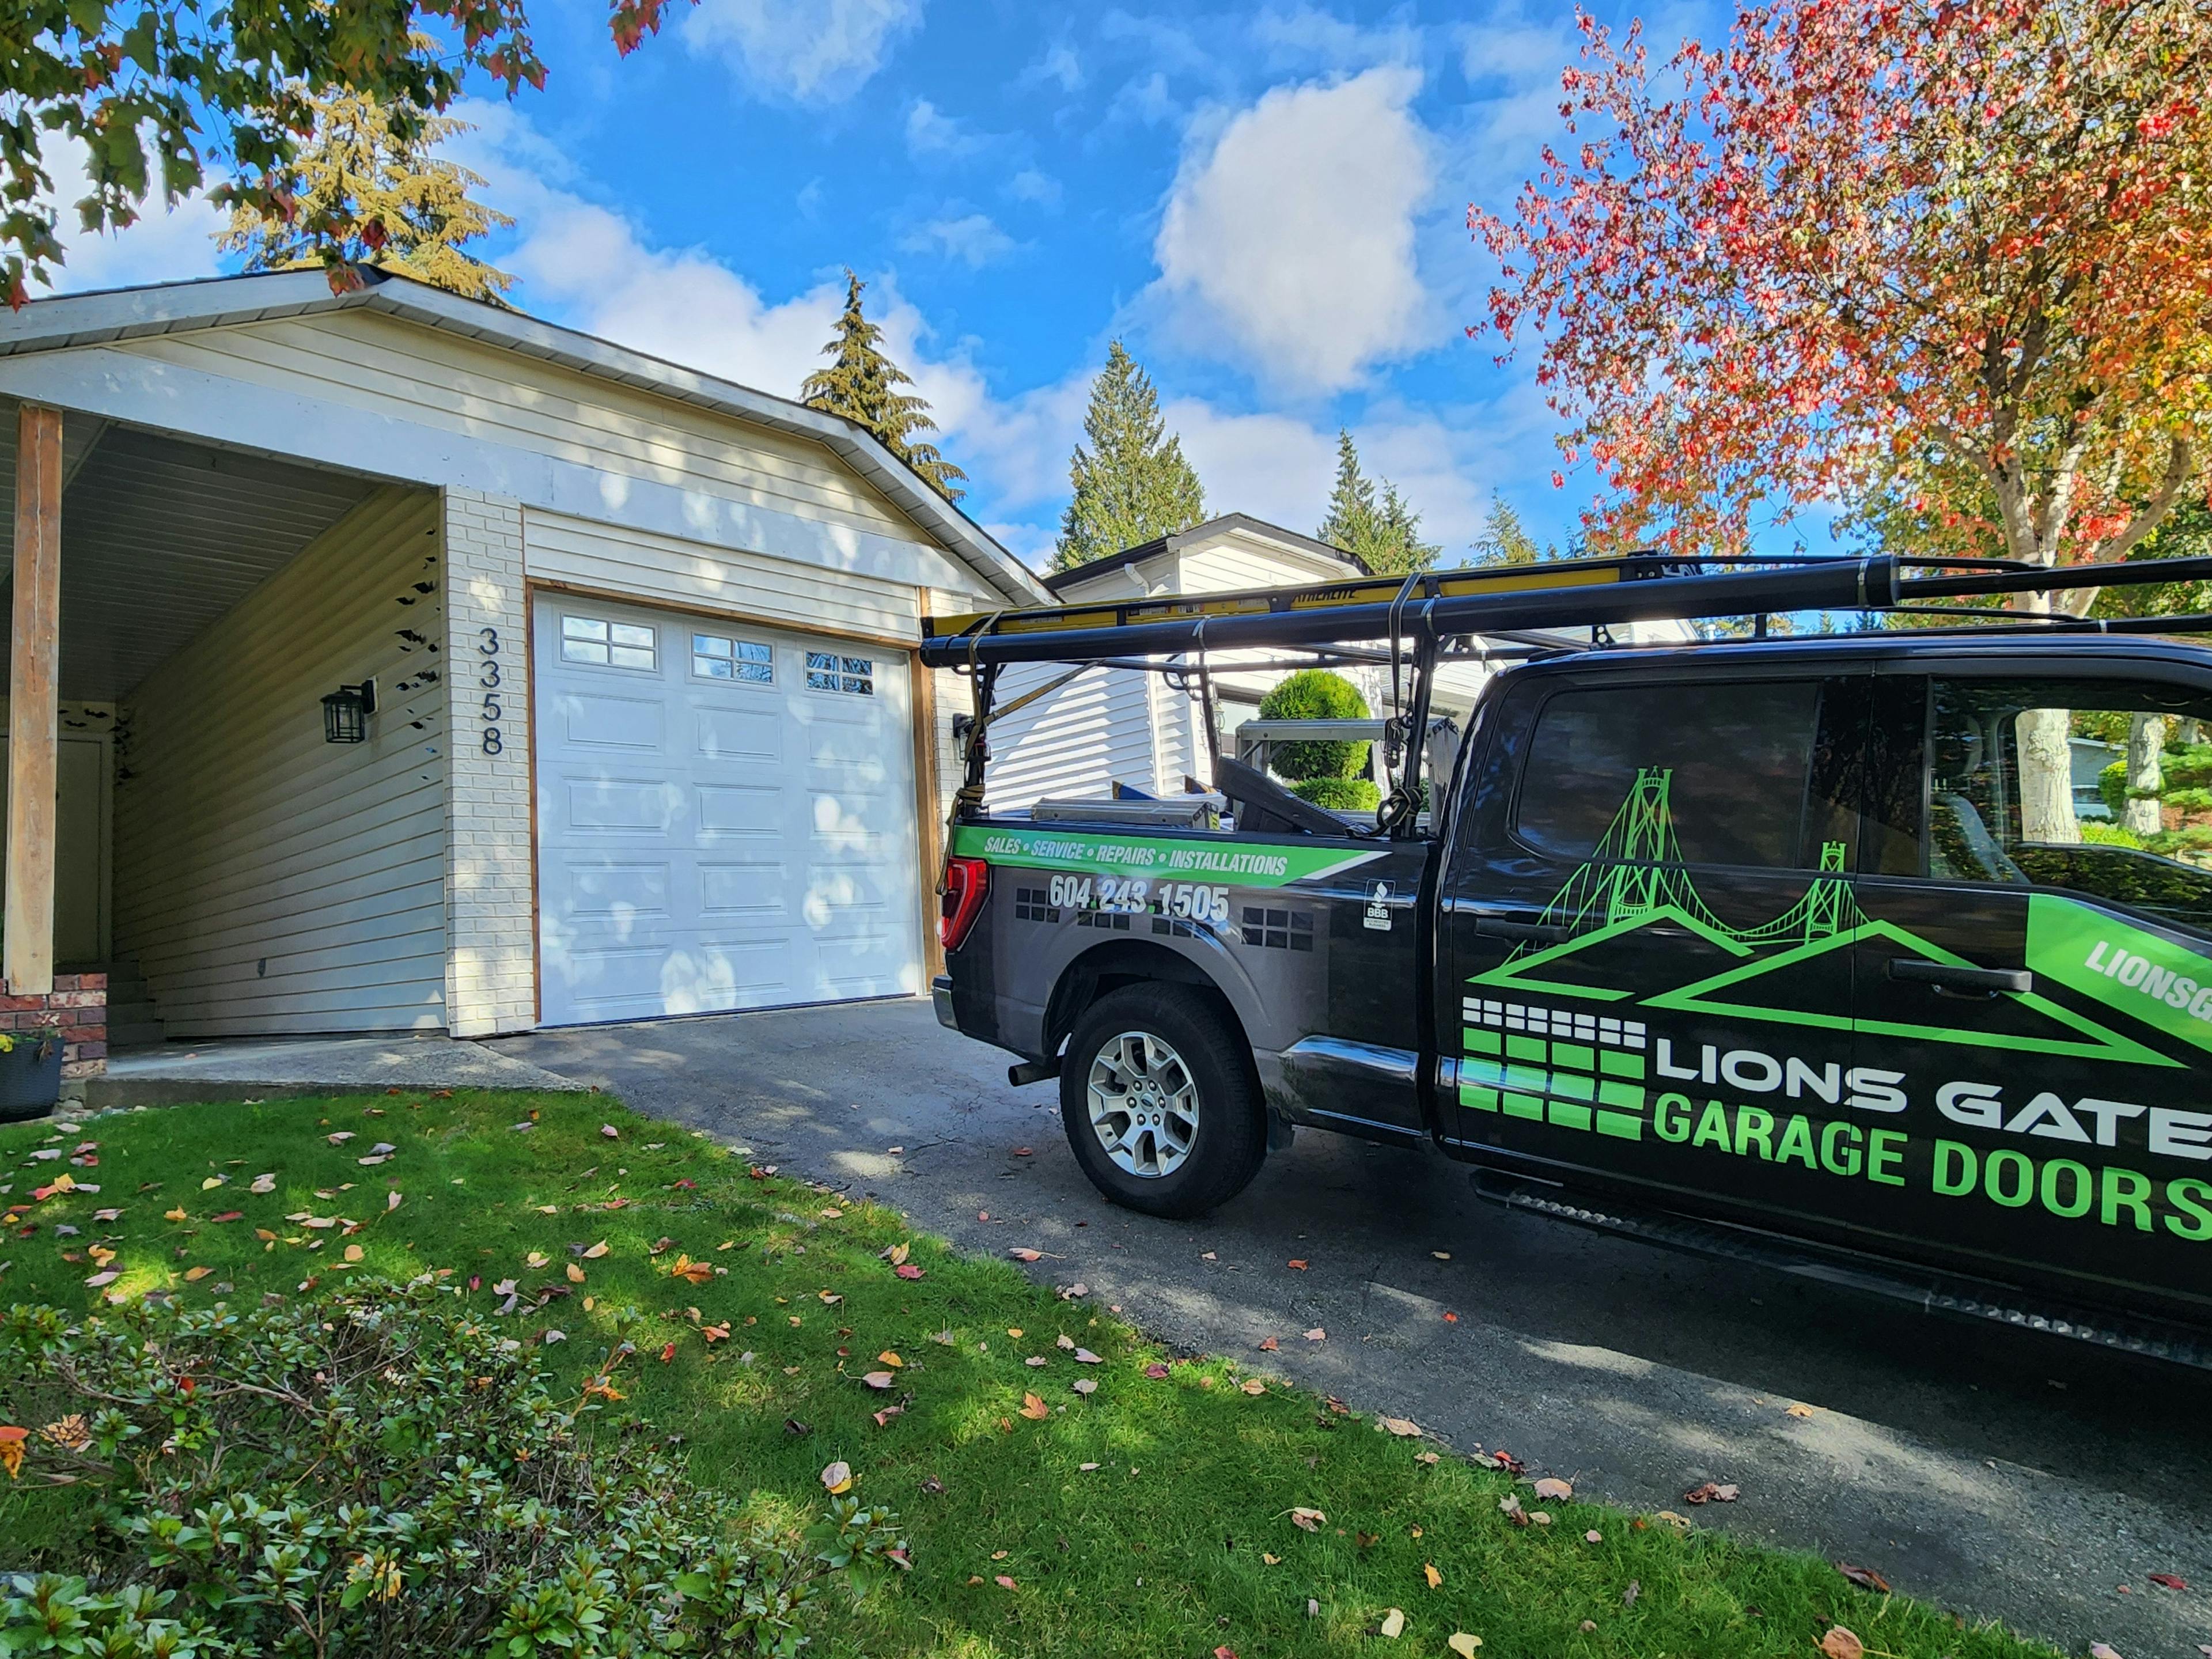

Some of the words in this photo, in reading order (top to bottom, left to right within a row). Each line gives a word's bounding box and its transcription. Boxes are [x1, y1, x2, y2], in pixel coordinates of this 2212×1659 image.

[480, 628, 502, 755] 3358
[984, 836, 1021, 854] SALES
[1031, 840, 1085, 859] SERVICE
[1096, 845, 1156, 865] REPAIRS
[1169, 850, 1288, 876] INSTALLATIONS
[1050, 875, 1229, 922] 604.243.1505
[1368, 907, 1388, 918] BBB
[2084, 941, 2212, 1023] LIONSG
[1657, 1038, 1907, 1112] LIONS
[1936, 1081, 2212, 1160] GATE
[1654, 1093, 1908, 1187] GARAGE
[1933, 1139, 2212, 1241] DOORS
